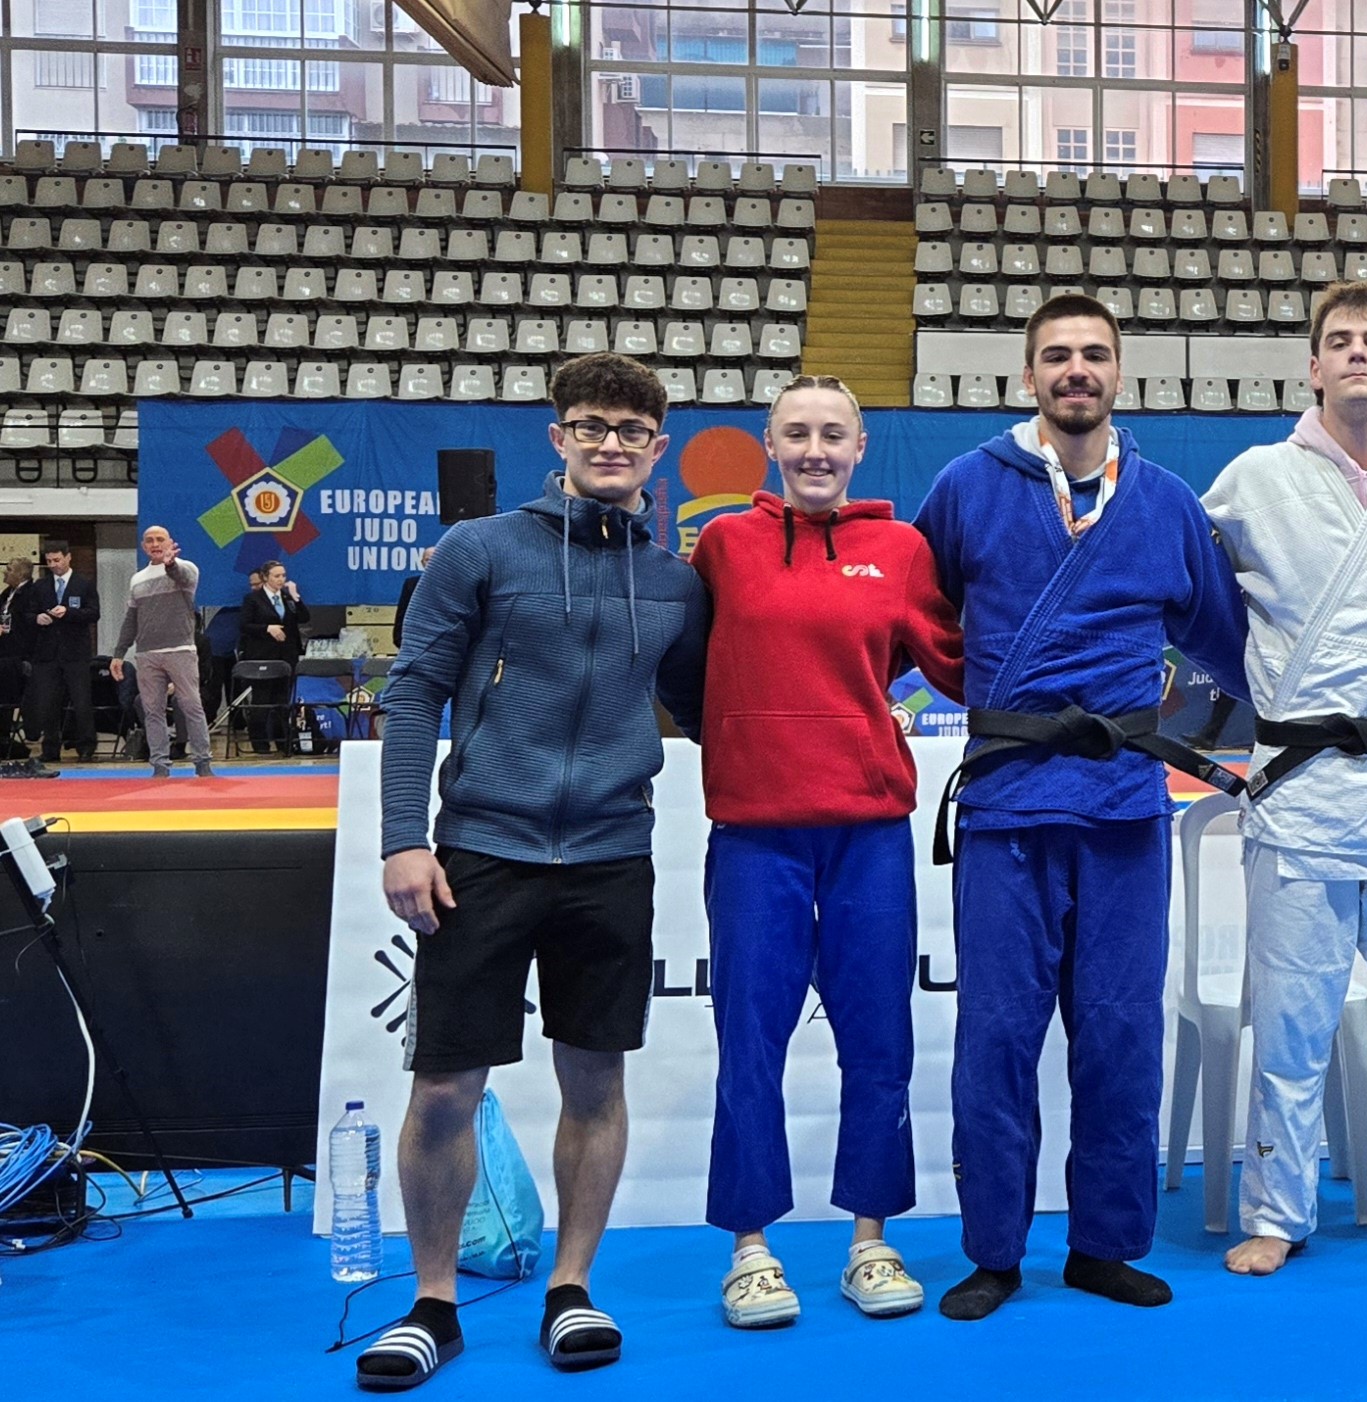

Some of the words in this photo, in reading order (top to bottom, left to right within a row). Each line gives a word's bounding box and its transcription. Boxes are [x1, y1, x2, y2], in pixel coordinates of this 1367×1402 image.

[320, 489, 440, 515] EUROPEA
[353, 518, 417, 543] JUDO
[347, 546, 425, 571] UNION
[921, 713, 968, 725] EUROPE
